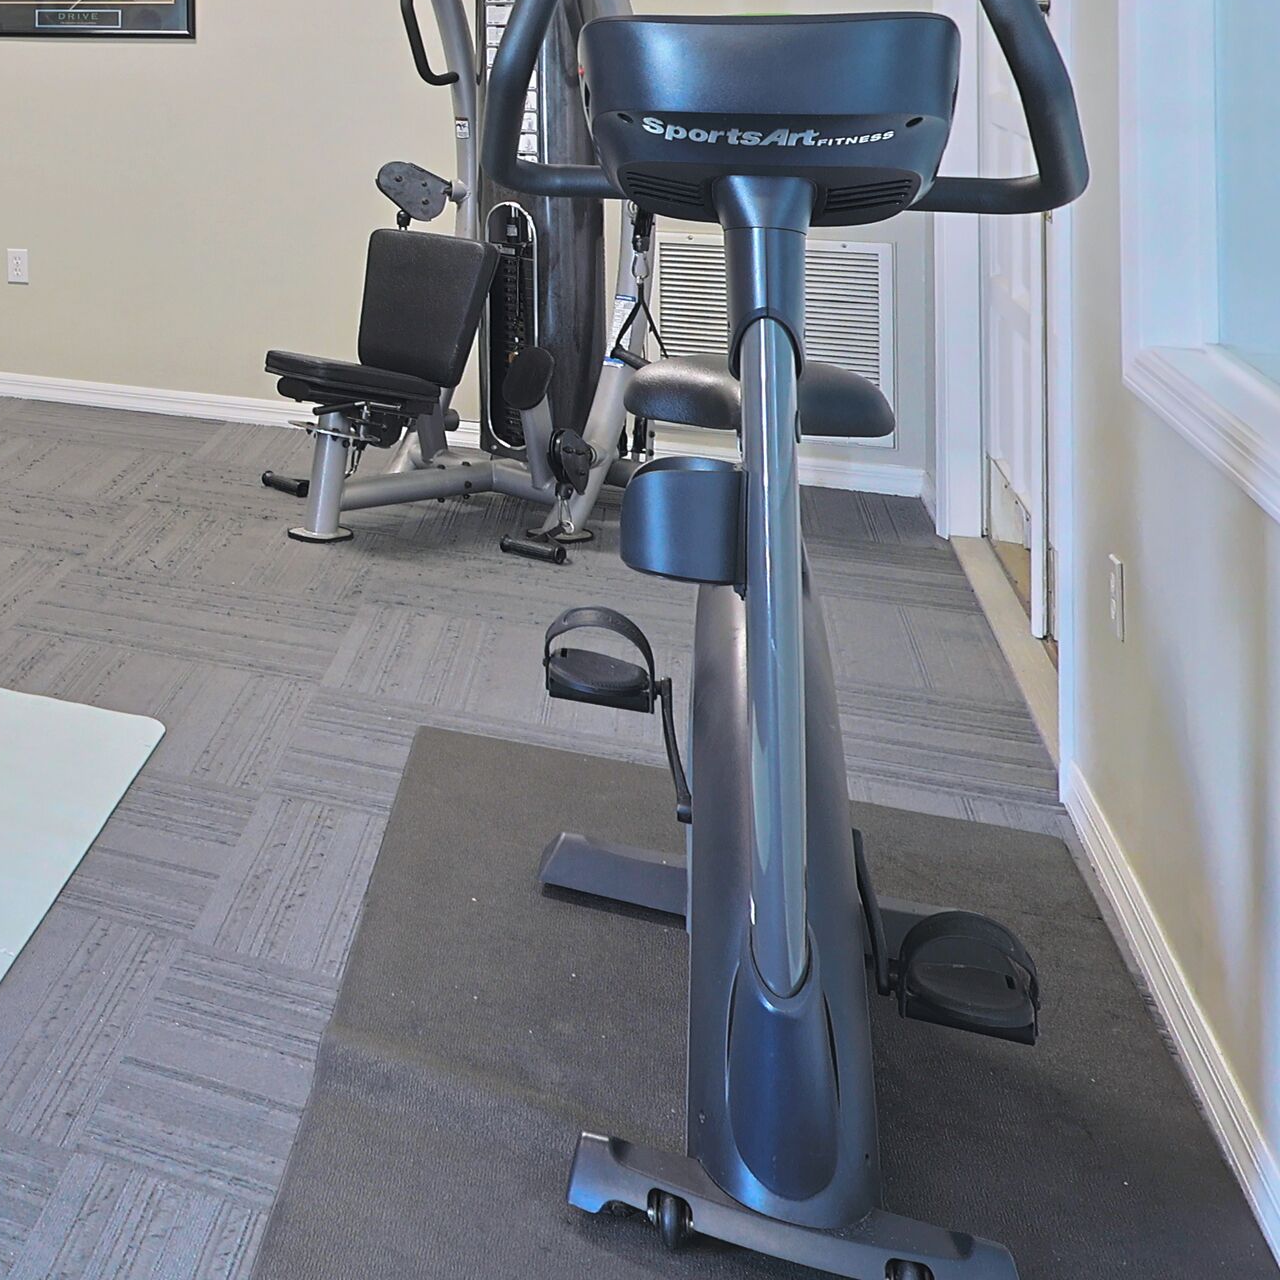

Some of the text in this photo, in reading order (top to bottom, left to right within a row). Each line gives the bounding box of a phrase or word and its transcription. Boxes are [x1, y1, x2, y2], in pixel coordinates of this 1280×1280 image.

[58, 12, 99, 20] DRIVE
[641, 116, 895, 147] SportsArt FITNESS
